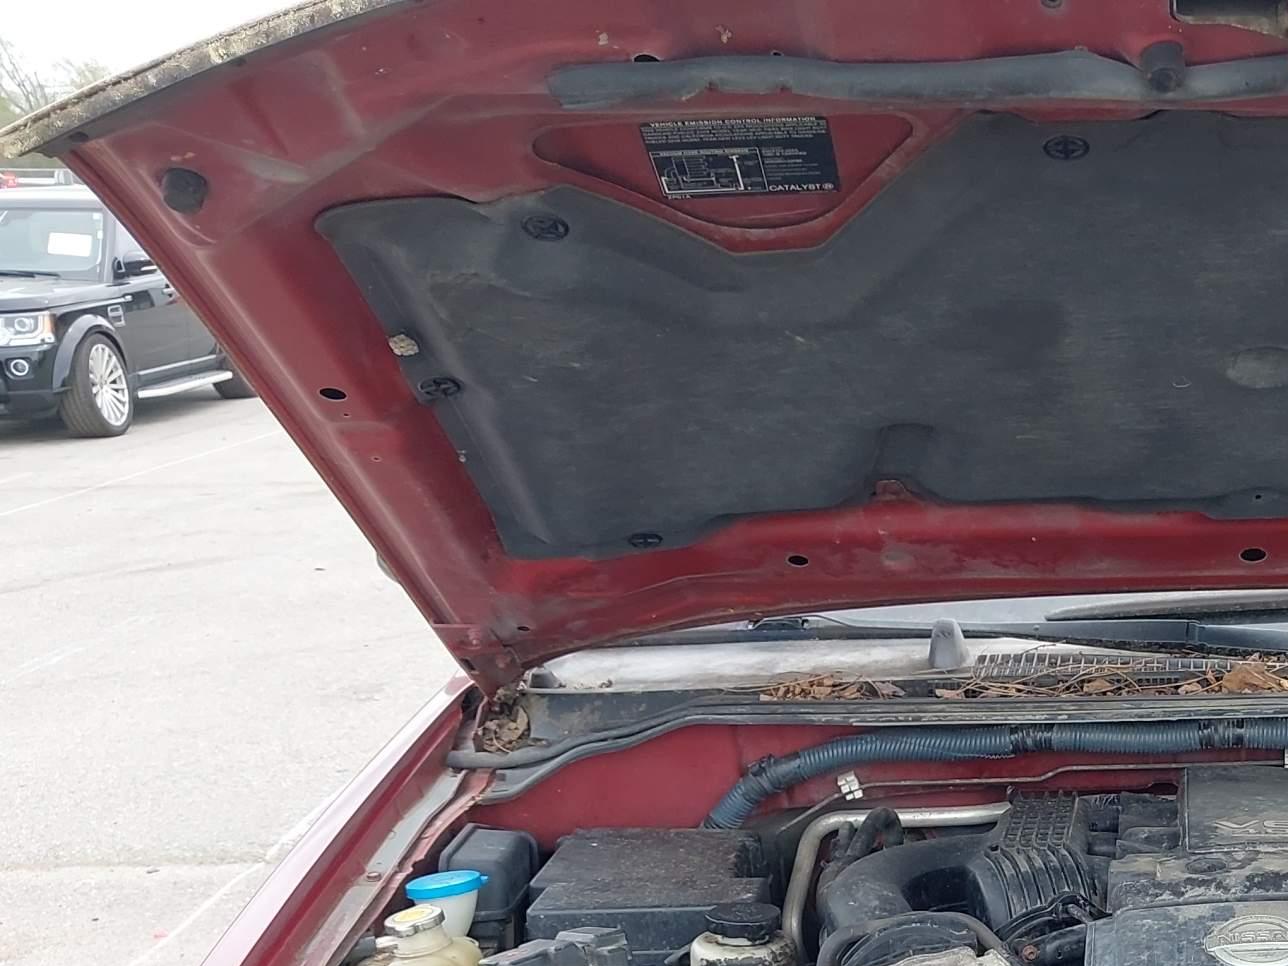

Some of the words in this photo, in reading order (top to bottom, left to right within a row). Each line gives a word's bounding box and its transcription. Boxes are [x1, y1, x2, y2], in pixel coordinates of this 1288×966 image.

[650, 120, 682, 128] VEHICLE
[725, 117, 761, 125] CONTROL
[763, 116, 816, 124] INFORMATION
[769, 183, 821, 192] CATALYST
